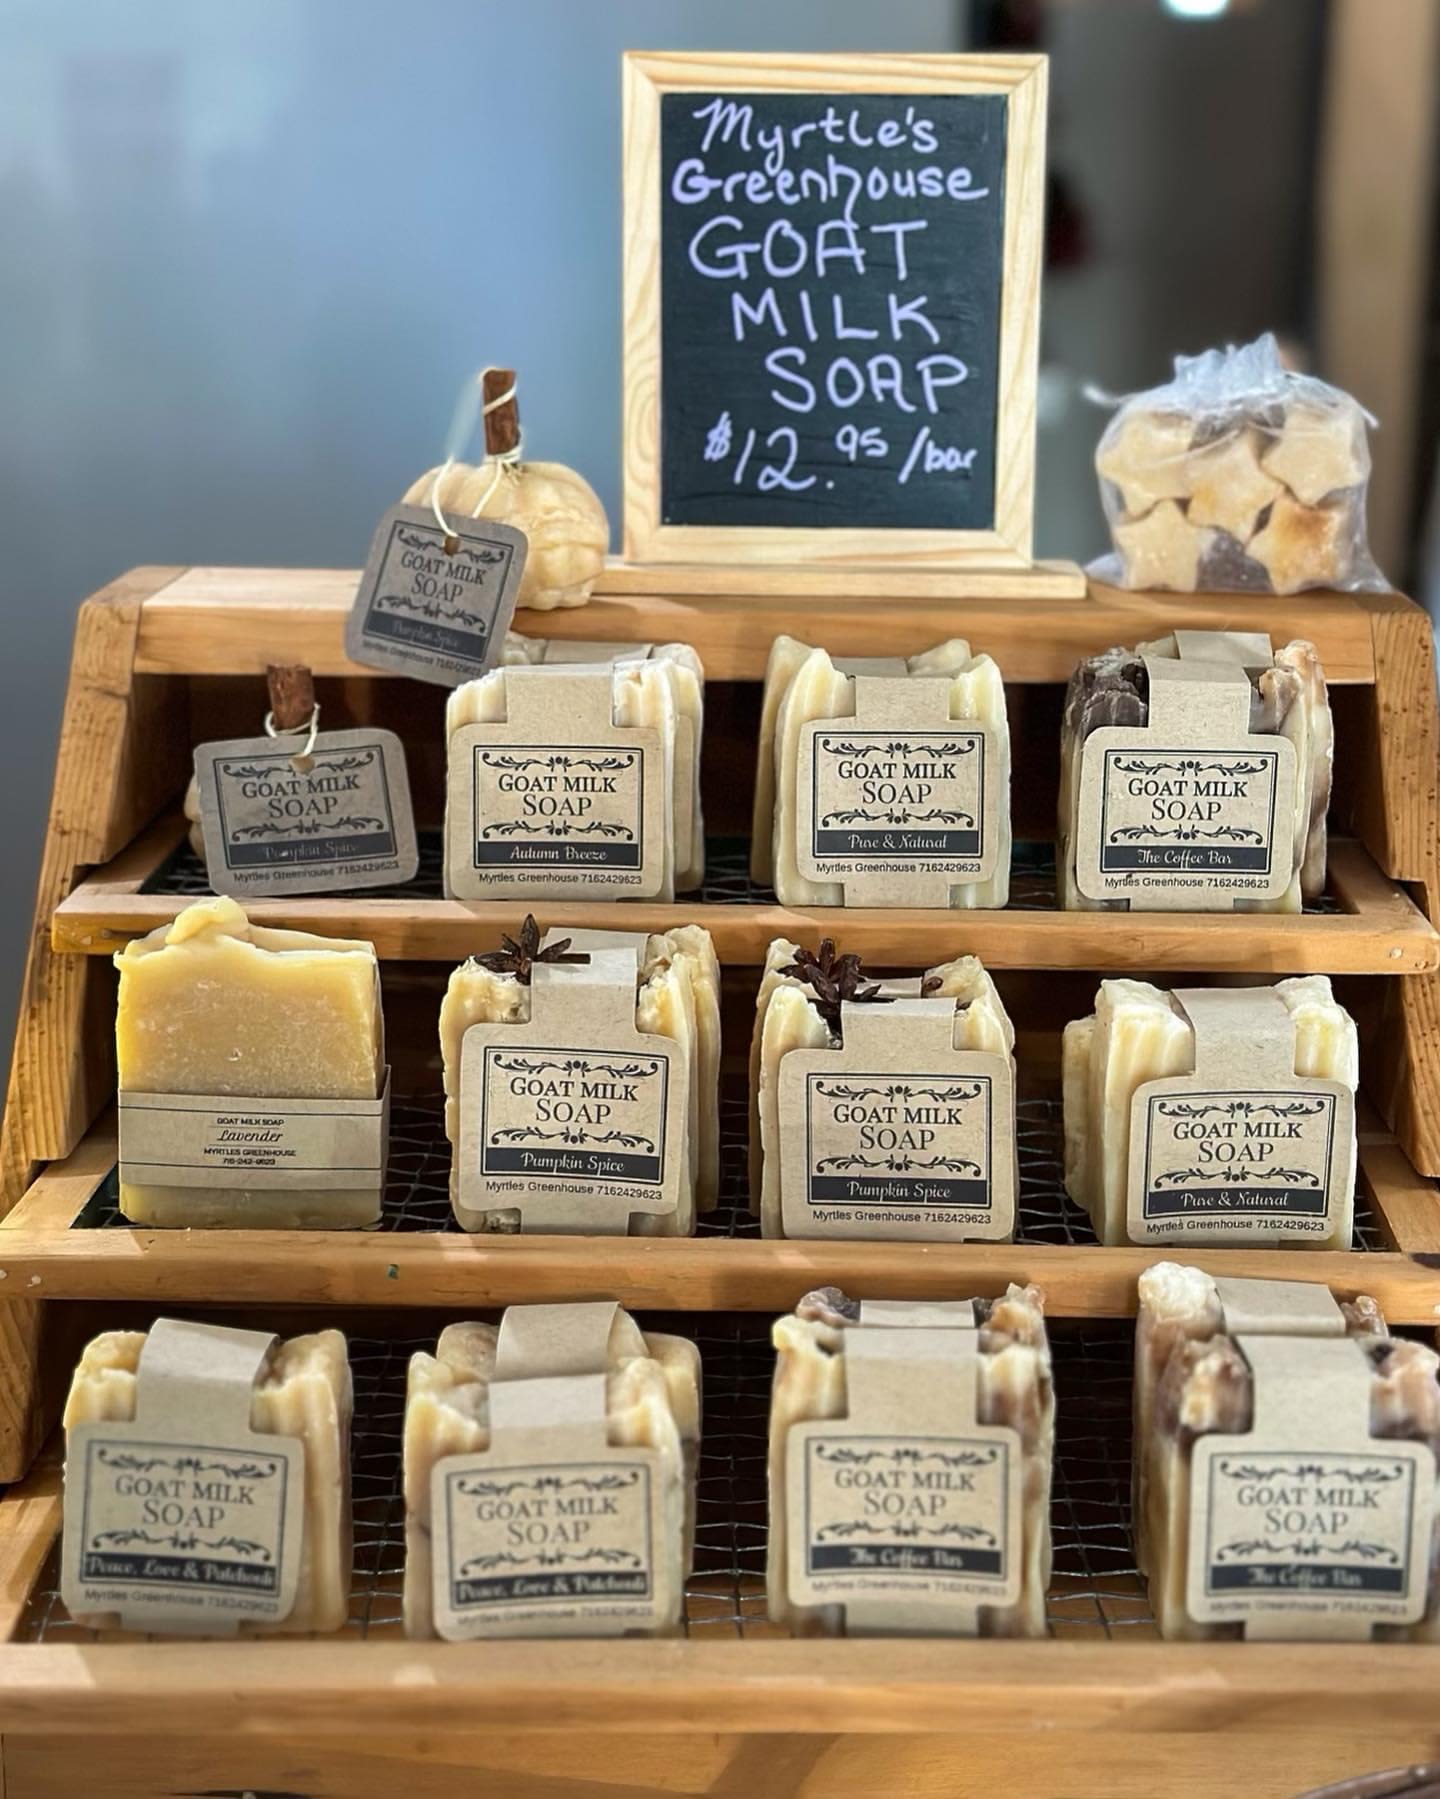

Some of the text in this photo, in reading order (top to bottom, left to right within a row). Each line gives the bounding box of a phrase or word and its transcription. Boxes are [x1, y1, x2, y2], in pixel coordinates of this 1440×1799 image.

[693, 98, 939, 174] Myrtle's
[672, 154, 989, 223] Greenhouse
[689, 216, 928, 281] GOAT
[731, 288, 940, 343] MILK
[765, 347, 968, 413] SOAP
[899, 426, 977, 484] /bar
[401, 551, 487, 585] GOAT MILK
[412, 573, 463, 602] SOAP
[839, 761, 956, 779] GOAT MILK
[242, 774, 360, 798] GOAT MILK
[499, 774, 617, 793] GOAT MILK
[863, 781, 932, 804] SOAP
[1129, 778, 1248, 797] GOAT MILK
[268, 797, 338, 819] SOAP
[523, 794, 592, 816] SOAP
[1152, 798, 1221, 821] SOAP
[848, 834, 947, 849] Pure & Natural
[510, 846, 607, 861] Autumn Breeze
[1138, 849, 1232, 869] The Coffee Bar
[479, 873, 642, 885] Myrtles Greenhouse 7162429623
[816, 863, 981, 874] Myrtles Greenhouse 7162429623
[1105, 877, 1269, 889] Myrtles Greenhouse 7162429623
[510, 1077, 639, 1101] GOAT MILK
[536, 1098, 611, 1124] SOAP
[833, 1104, 962, 1125] GOAT MILK
[216, 1130, 283, 1142] Lavender
[860, 1125, 935, 1150] SOAP
[1174, 1122, 1303, 1139] GOAT MILK
[1198, 1141, 1274, 1163] SOAP
[521, 1152, 624, 1176] Pumpkin Spice
[486, 1182, 662, 1200] Myrtles Greenhouse 7162429623
[847, 1182, 951, 1203] Pumpkin Spice
[1181, 1192, 1288, 1207] Pure & Natural
[813, 1210, 991, 1224] Myrtles Greenhouse 7162429623
[1147, 1219, 1324, 1235] Myrtles Greenhouse 7162429623
[115, 1475, 255, 1505] GOAT MILK
[834, 1469, 976, 1492] GOAT MILK
[476, 1495, 619, 1521] GOAT MILK
[864, 1489, 947, 1517] SOAP
[1237, 1485, 1380, 1509] GOAT MILK
[142, 1500, 225, 1529] SOAP
[1265, 1508, 1349, 1535] SOAP
[507, 1520, 591, 1545] SOAP
